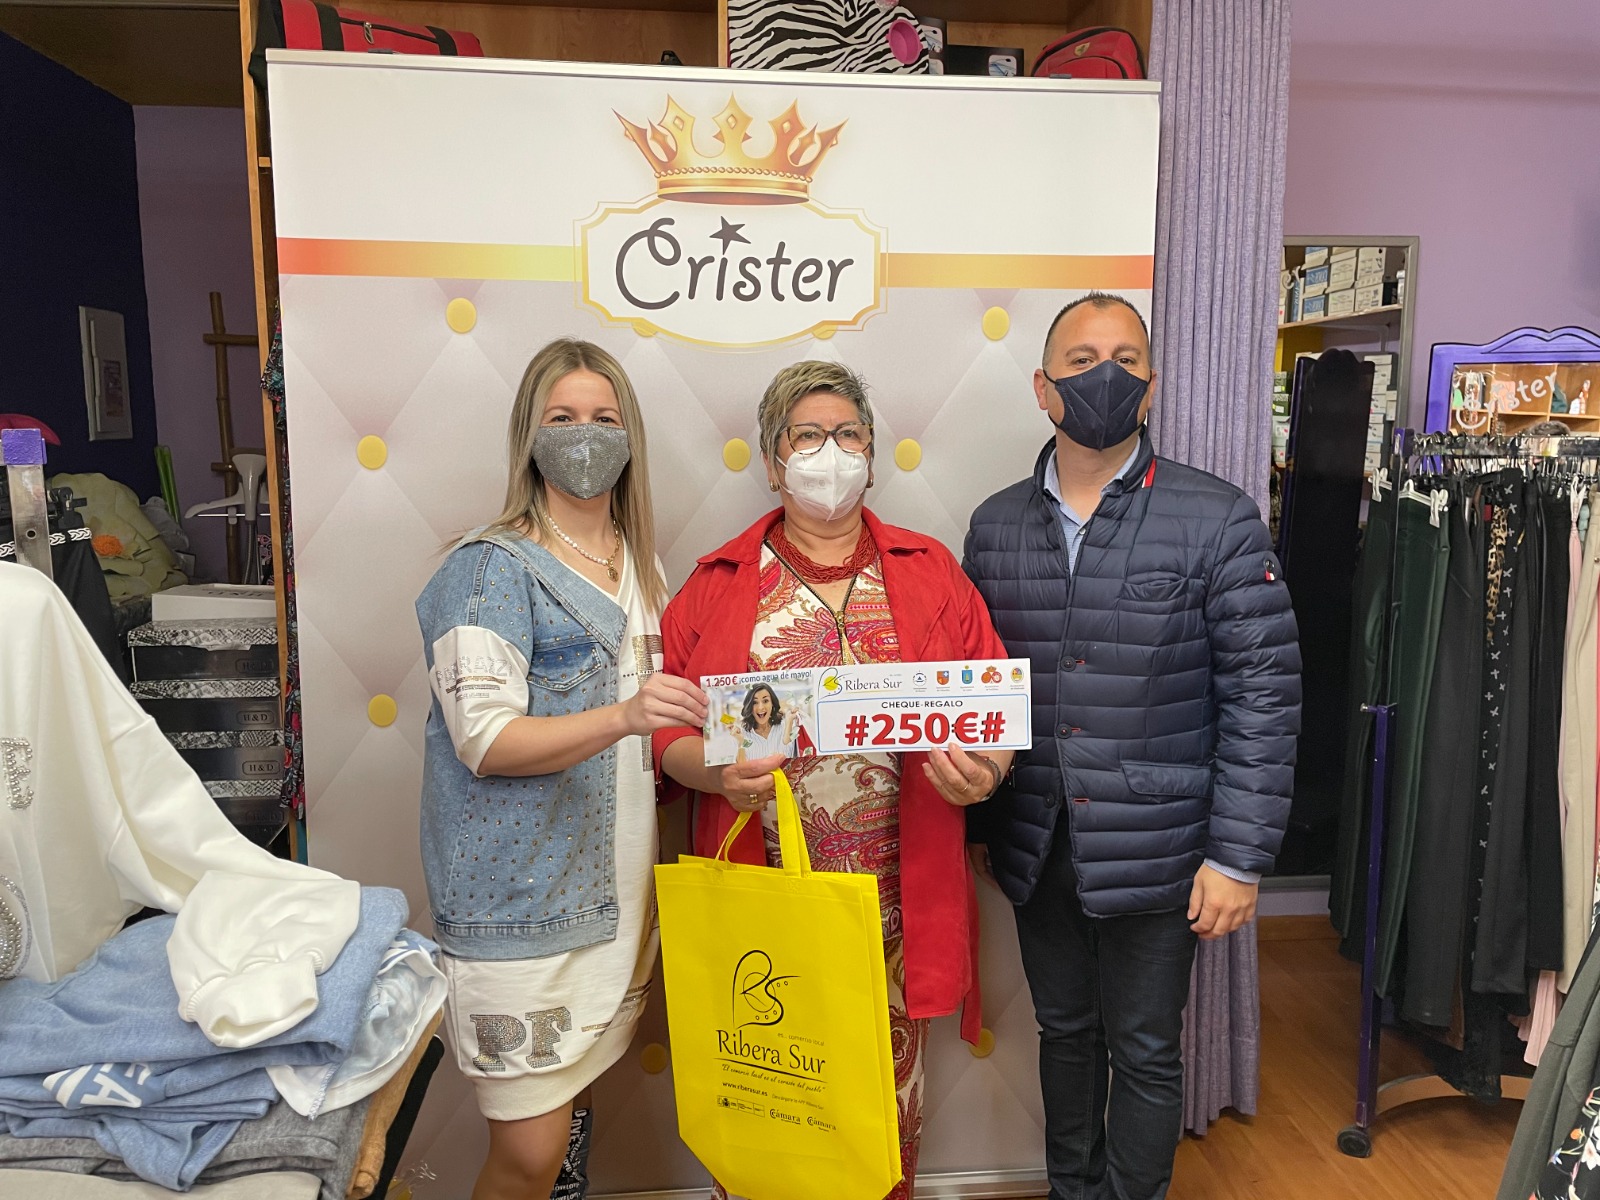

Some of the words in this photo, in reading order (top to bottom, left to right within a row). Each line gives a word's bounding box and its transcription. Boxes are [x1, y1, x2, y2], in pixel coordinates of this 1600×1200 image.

[616, 215, 854, 310] Crister
[763, 674, 779, 683] agua
[791, 669, 812, 680] mayo!
[845, 677, 880, 691] Ribera
[883, 677, 903, 689] Sur
[845, 710, 1006, 747] #250€#
[469, 1006, 573, 1072] PF
[715, 1029, 783, 1067] Ribera
[789, 1044, 826, 1074] Sur
